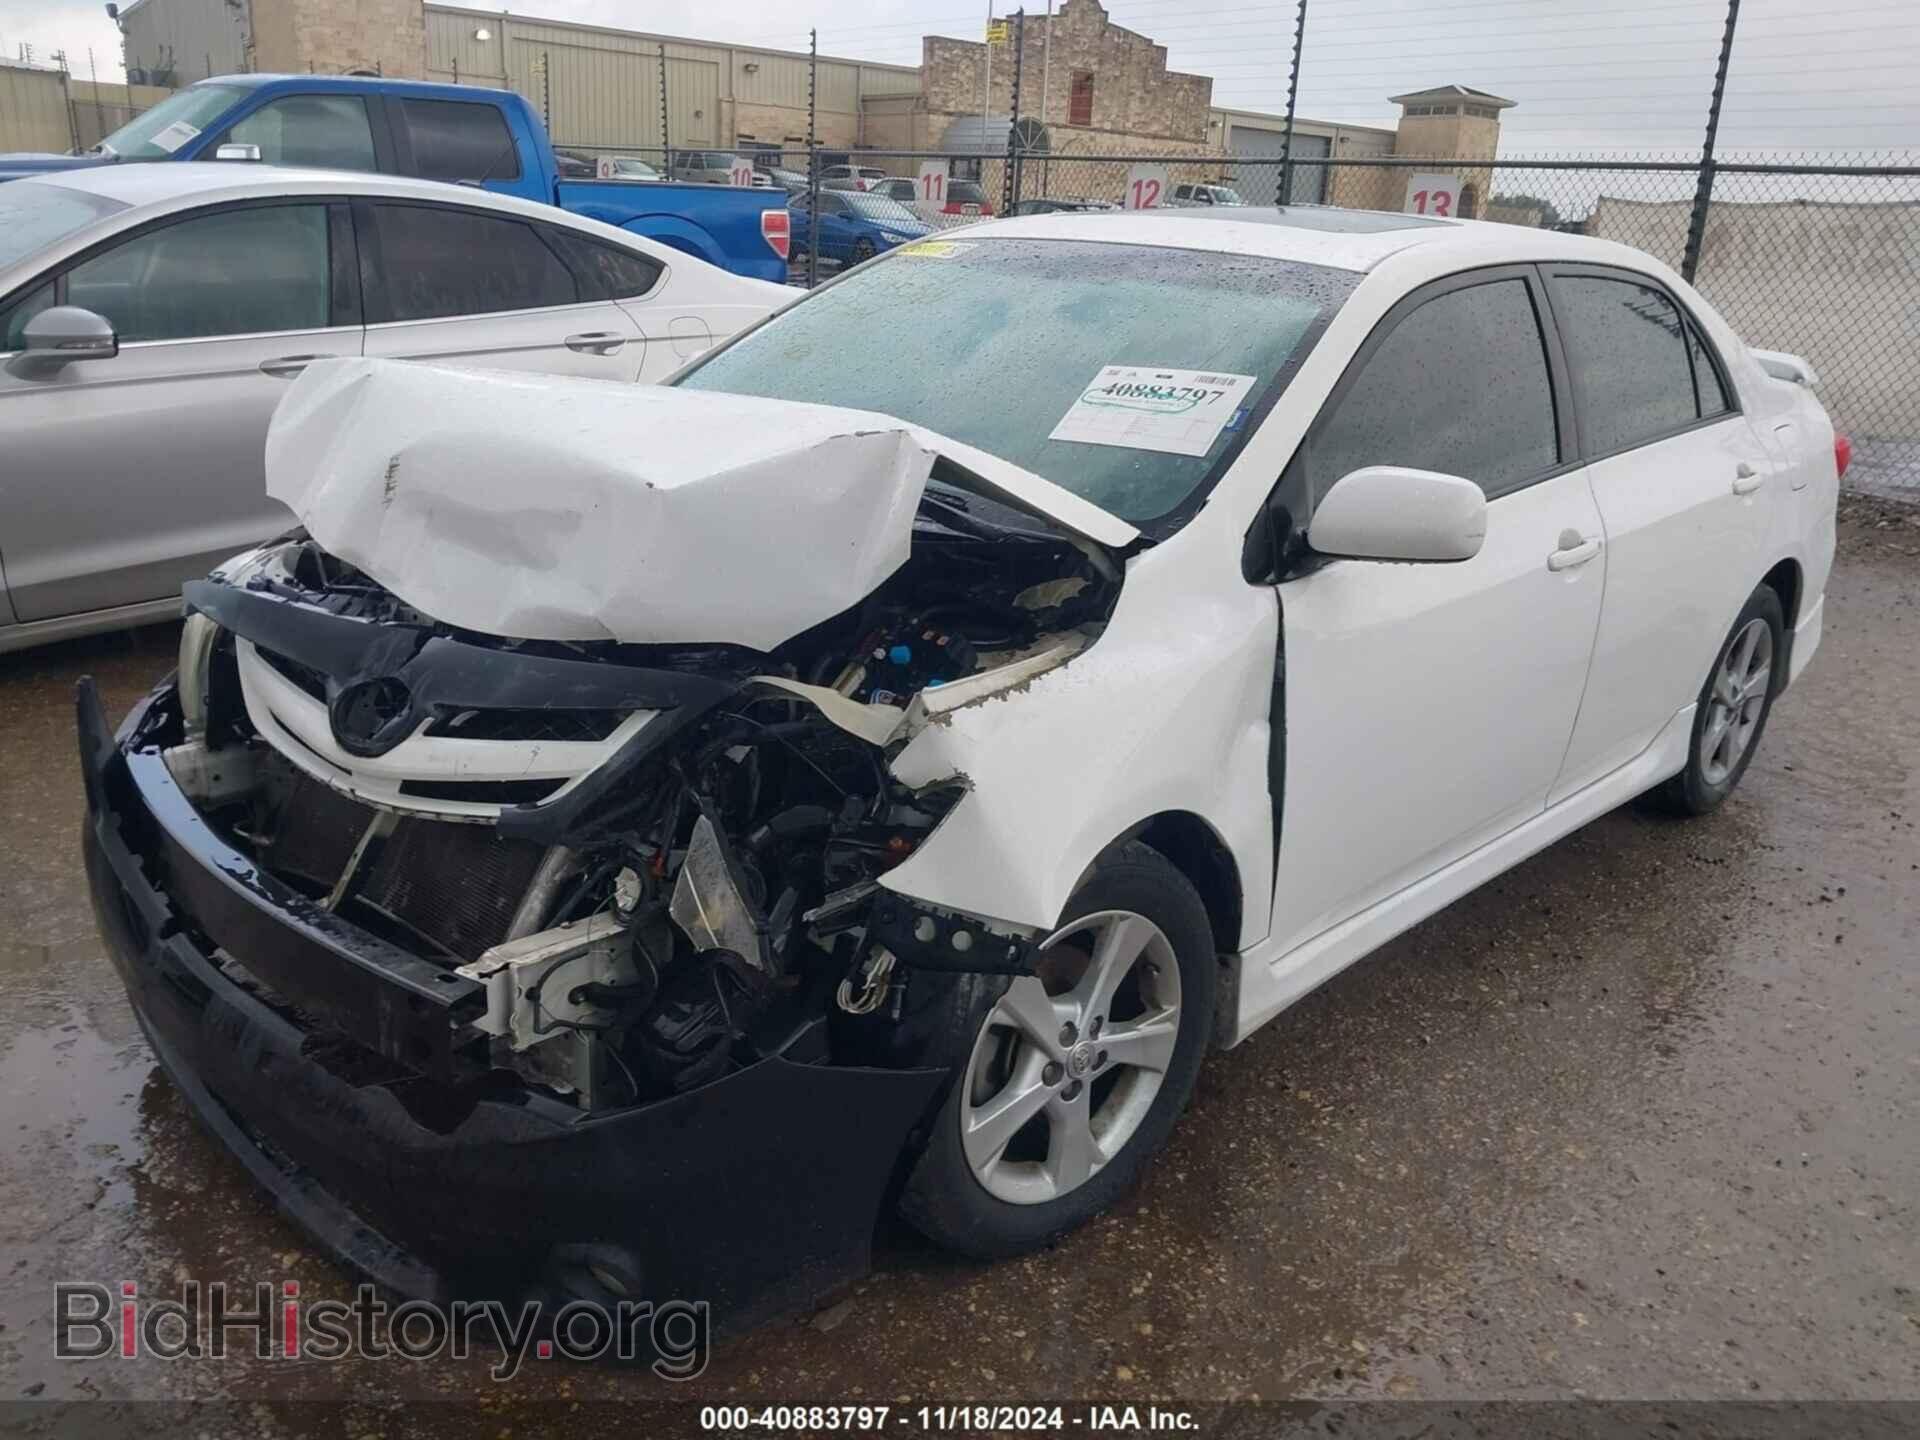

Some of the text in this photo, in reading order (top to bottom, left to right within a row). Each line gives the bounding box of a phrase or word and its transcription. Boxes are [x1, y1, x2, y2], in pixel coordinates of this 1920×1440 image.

[923, 173, 943, 200] 11
[1132, 179, 1160, 205] 12
[1412, 190, 1452, 216] 13
[1101, 382, 1225, 405] 40883797
